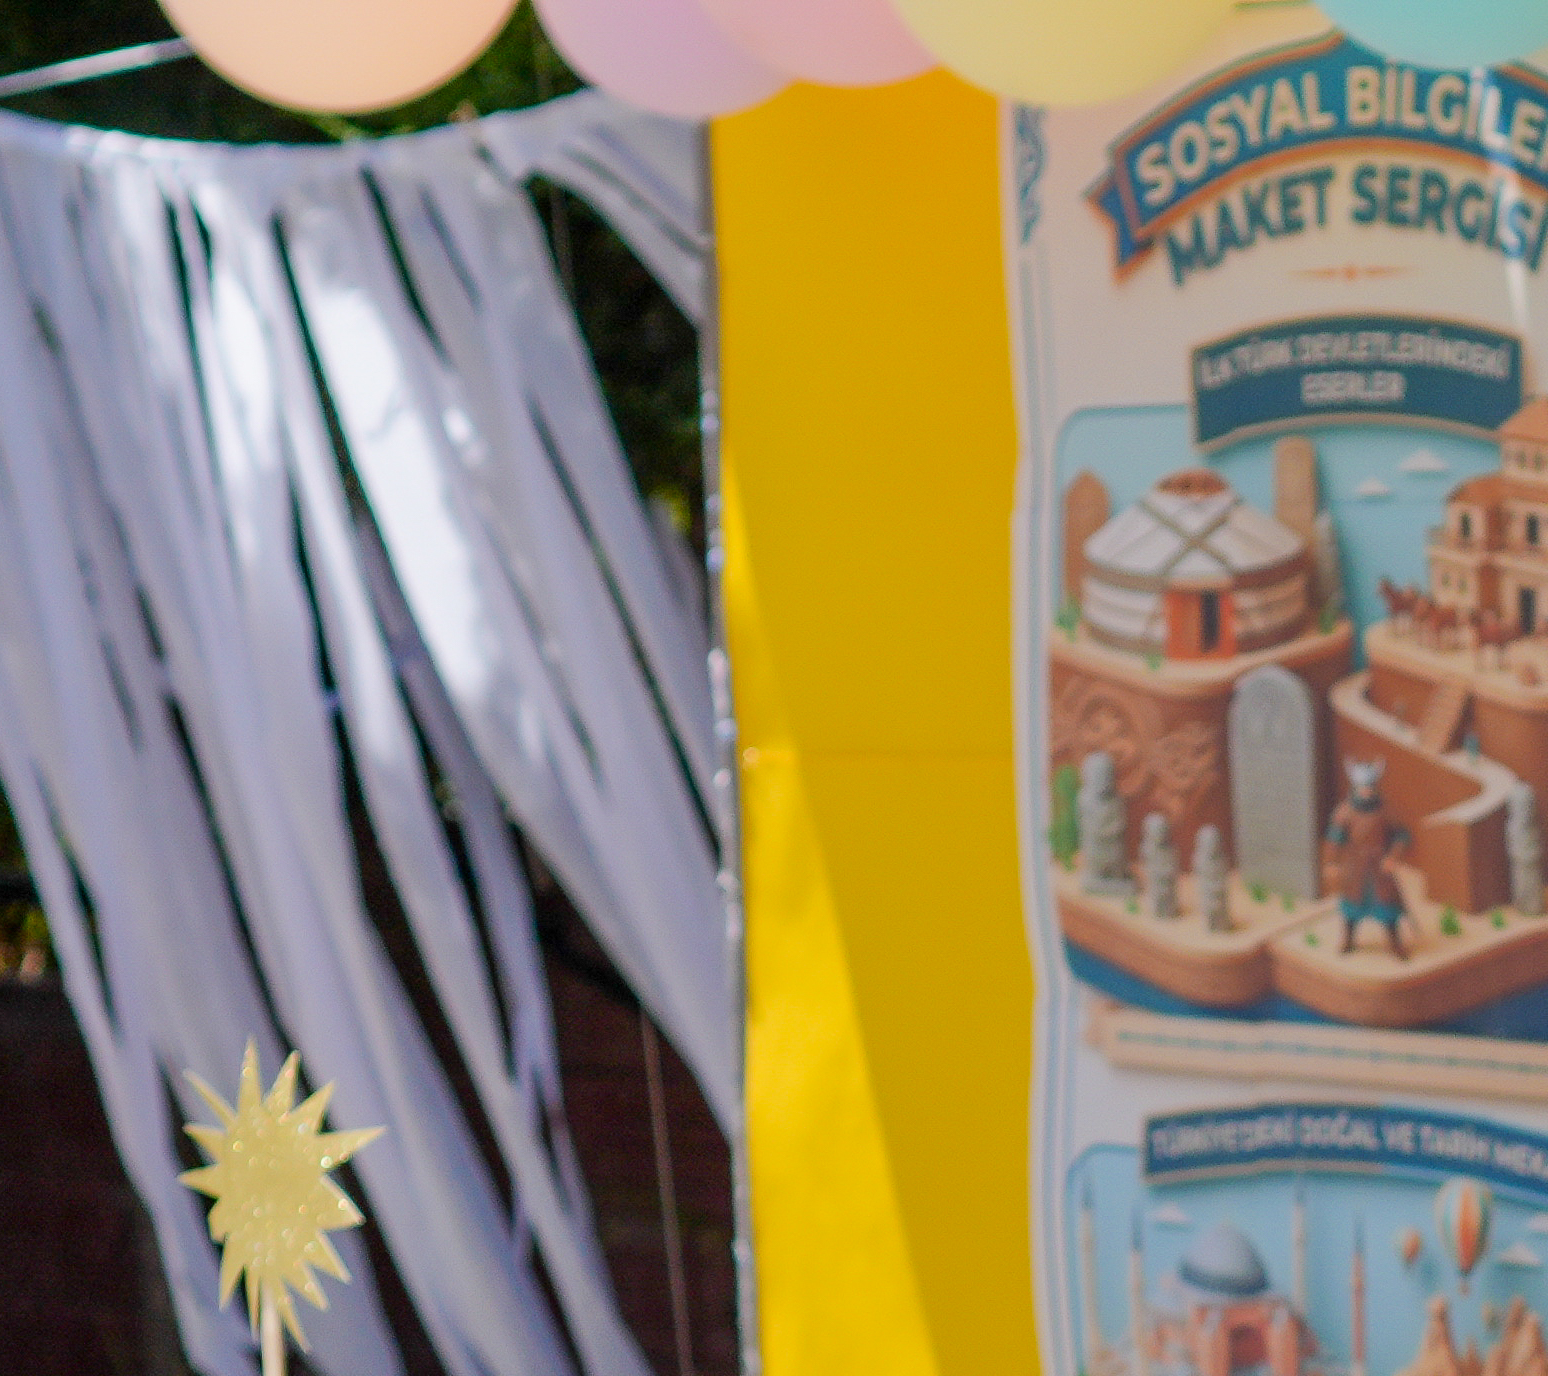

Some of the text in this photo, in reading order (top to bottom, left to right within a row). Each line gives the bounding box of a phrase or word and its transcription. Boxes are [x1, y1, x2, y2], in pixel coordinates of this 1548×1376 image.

[1135, 71, 1336, 204] SOSYAL
[1166, 165, 1336, 288] MAKET
[1299, 1110, 1380, 1150] DOĞAL
[1382, 1121, 1415, 1152] VE
